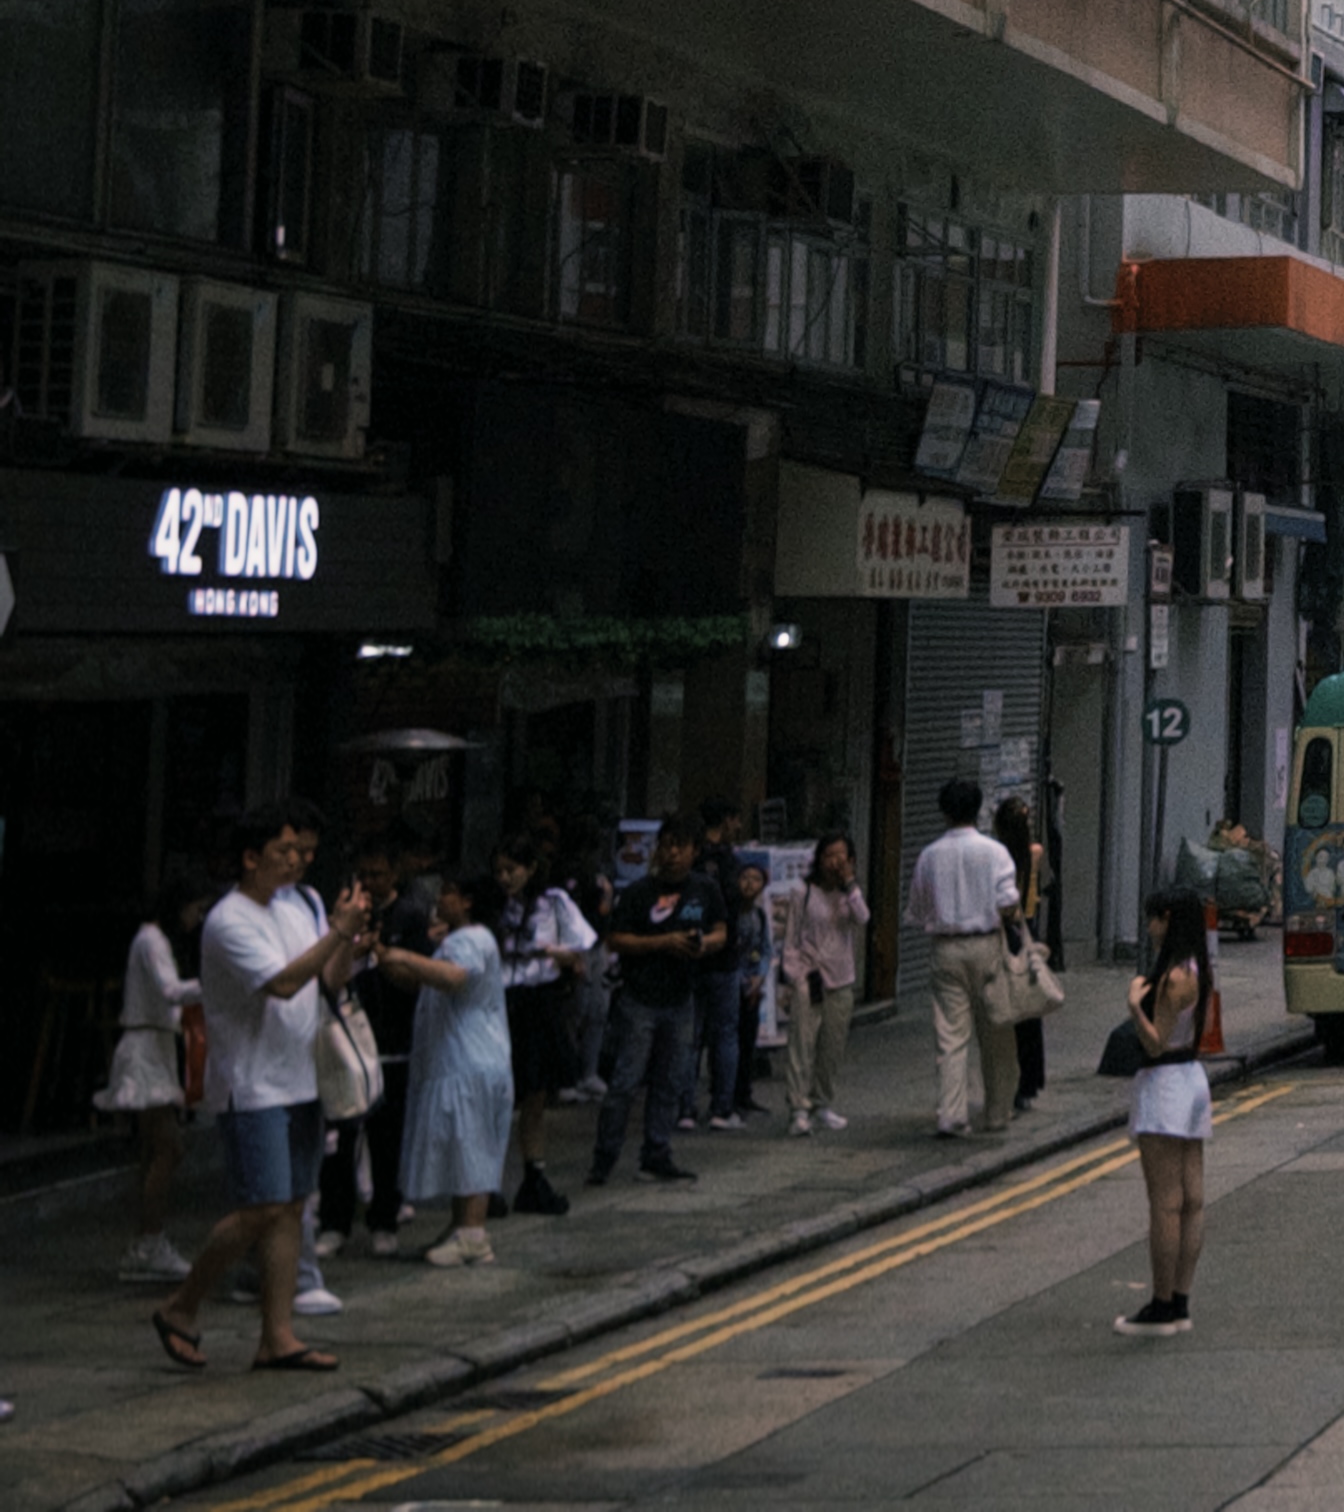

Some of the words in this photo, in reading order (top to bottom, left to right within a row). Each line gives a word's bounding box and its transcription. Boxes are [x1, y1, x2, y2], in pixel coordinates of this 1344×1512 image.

[220, 491, 320, 581] DAVIS
[192, 587, 236, 616] HONG
[238, 589, 280, 618] KONG
[1146, 709, 1184, 737] 12
